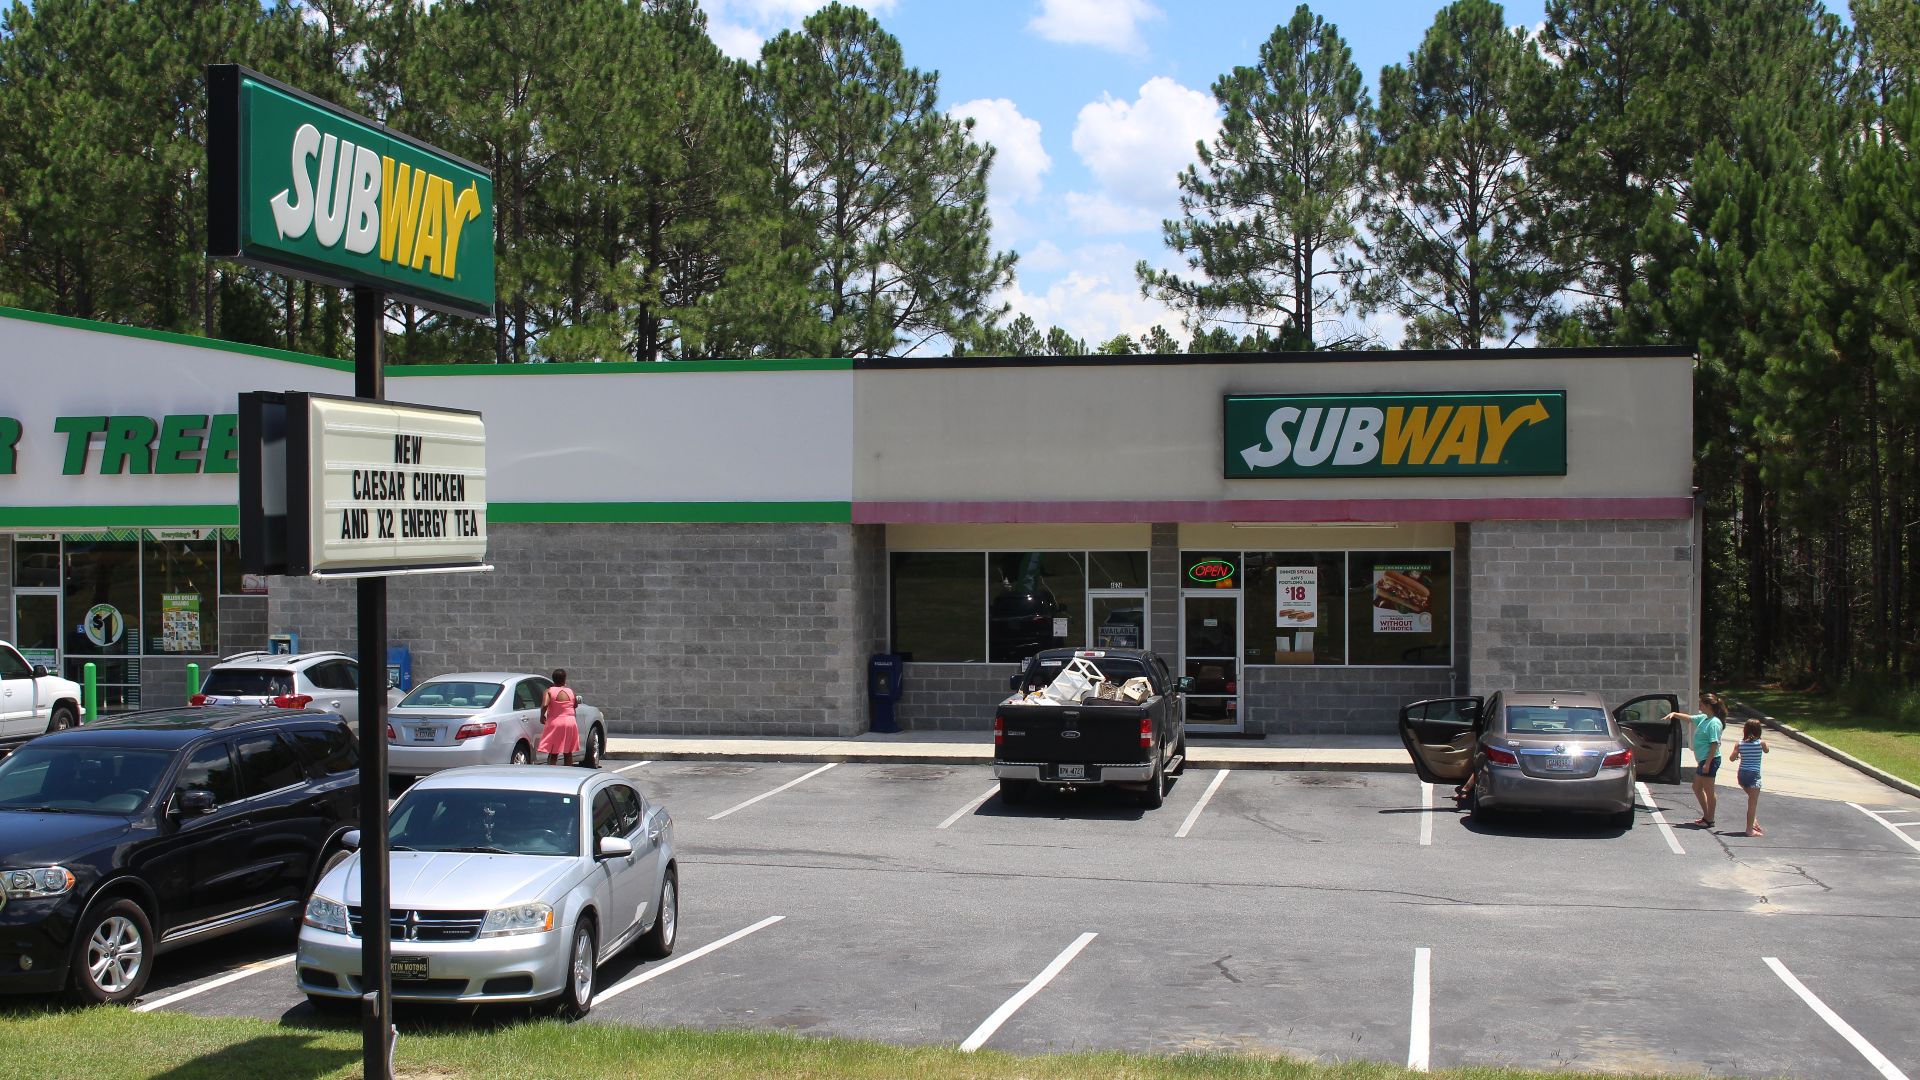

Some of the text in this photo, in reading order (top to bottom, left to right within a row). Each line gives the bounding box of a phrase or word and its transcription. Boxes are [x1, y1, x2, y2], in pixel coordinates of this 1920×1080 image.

[270, 124, 482, 280] SUBWAY
[54, 414, 239, 475] TREE
[395, 434, 422, 465] NEW
[1240, 398, 1550, 471] SUBWAY
[353, 470, 465, 502] CAESAR CHICKEN
[341, 508, 479, 540] AND X2 ENERGY TEA
[1195, 565, 1228, 577] OPEN
[1285, 586, 1306, 601] $18
[92, 611, 114, 645] $1
[390, 962, 427, 971] RTIN MOTORS
